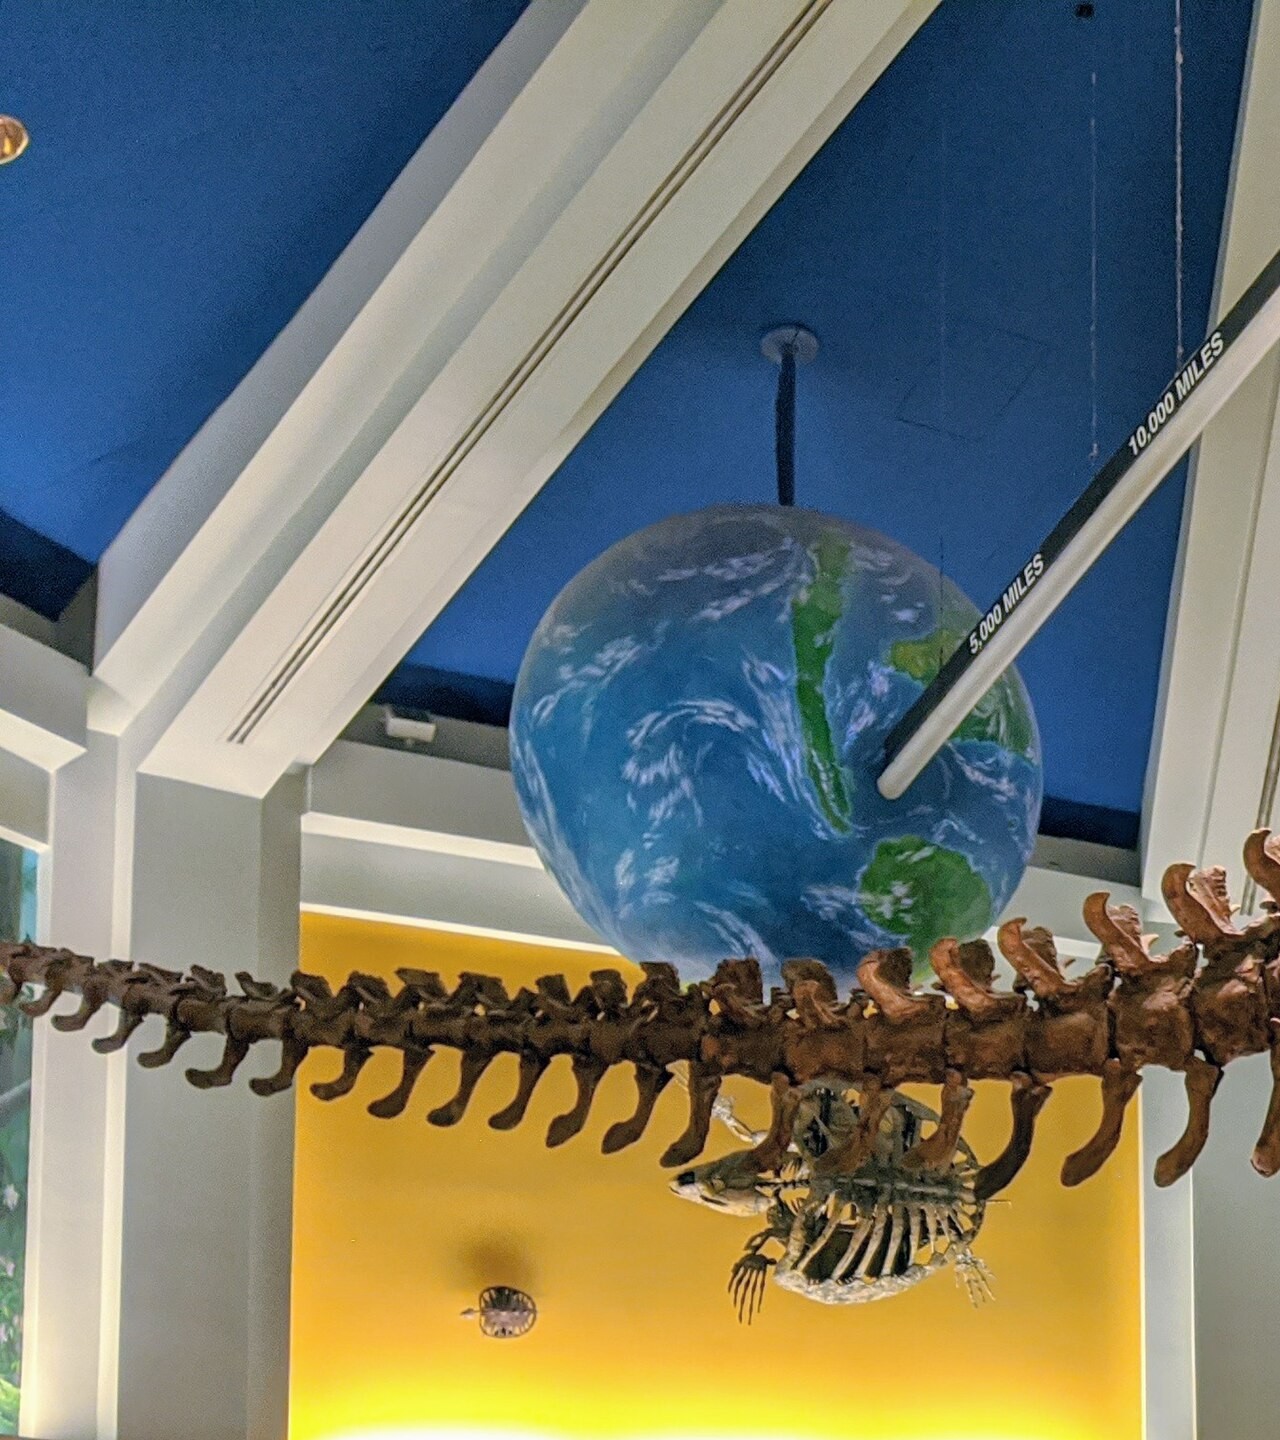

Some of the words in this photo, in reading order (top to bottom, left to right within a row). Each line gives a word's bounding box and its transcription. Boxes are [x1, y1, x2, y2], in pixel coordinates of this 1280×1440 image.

[1128, 392, 1175, 455] 10,000
[1175, 331, 1224, 400] MILES
[969, 603, 1002, 654] 5,000
[1002, 553, 1044, 613] MILES
